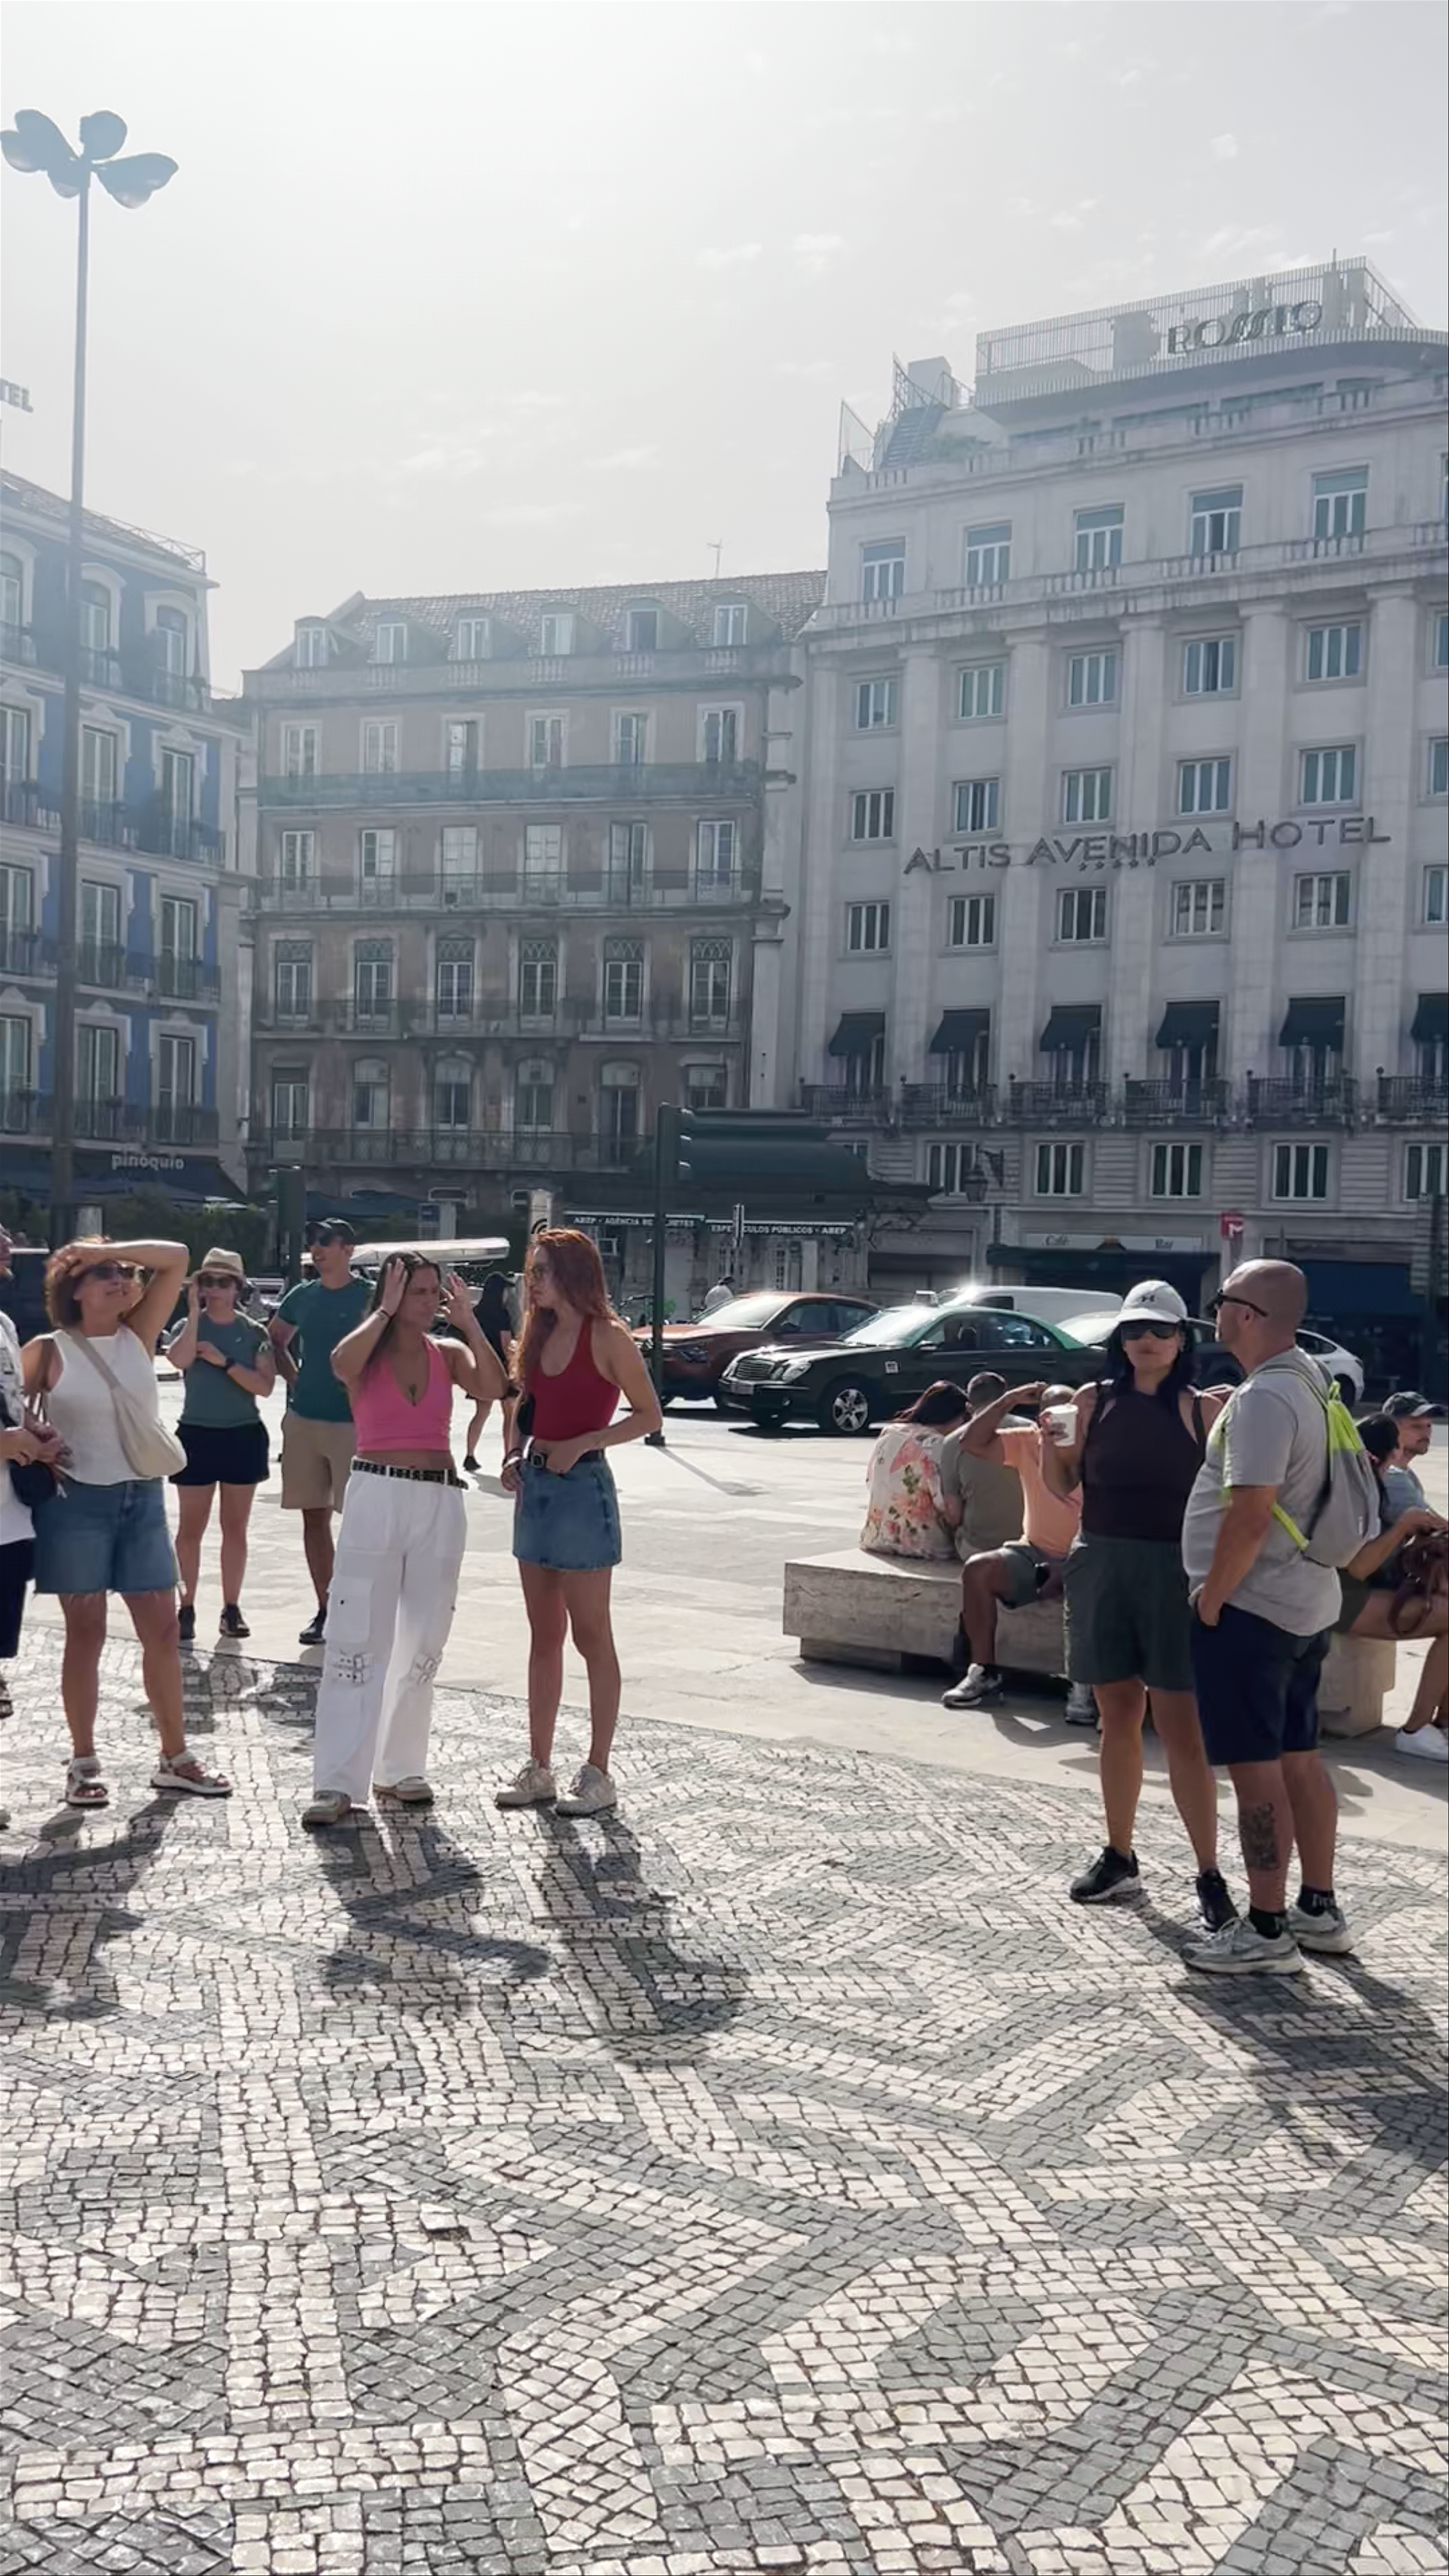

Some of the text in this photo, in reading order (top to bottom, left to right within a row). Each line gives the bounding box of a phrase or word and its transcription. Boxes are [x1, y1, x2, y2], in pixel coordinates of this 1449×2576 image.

[1168, 300, 1322, 354] ROSSIO
[903, 817, 1391, 875] ALTIS AVENIDA HOTEL
[112, 1152, 185, 1170] pinoquio
[711, 1225, 769, 1233] ESPECULOS
